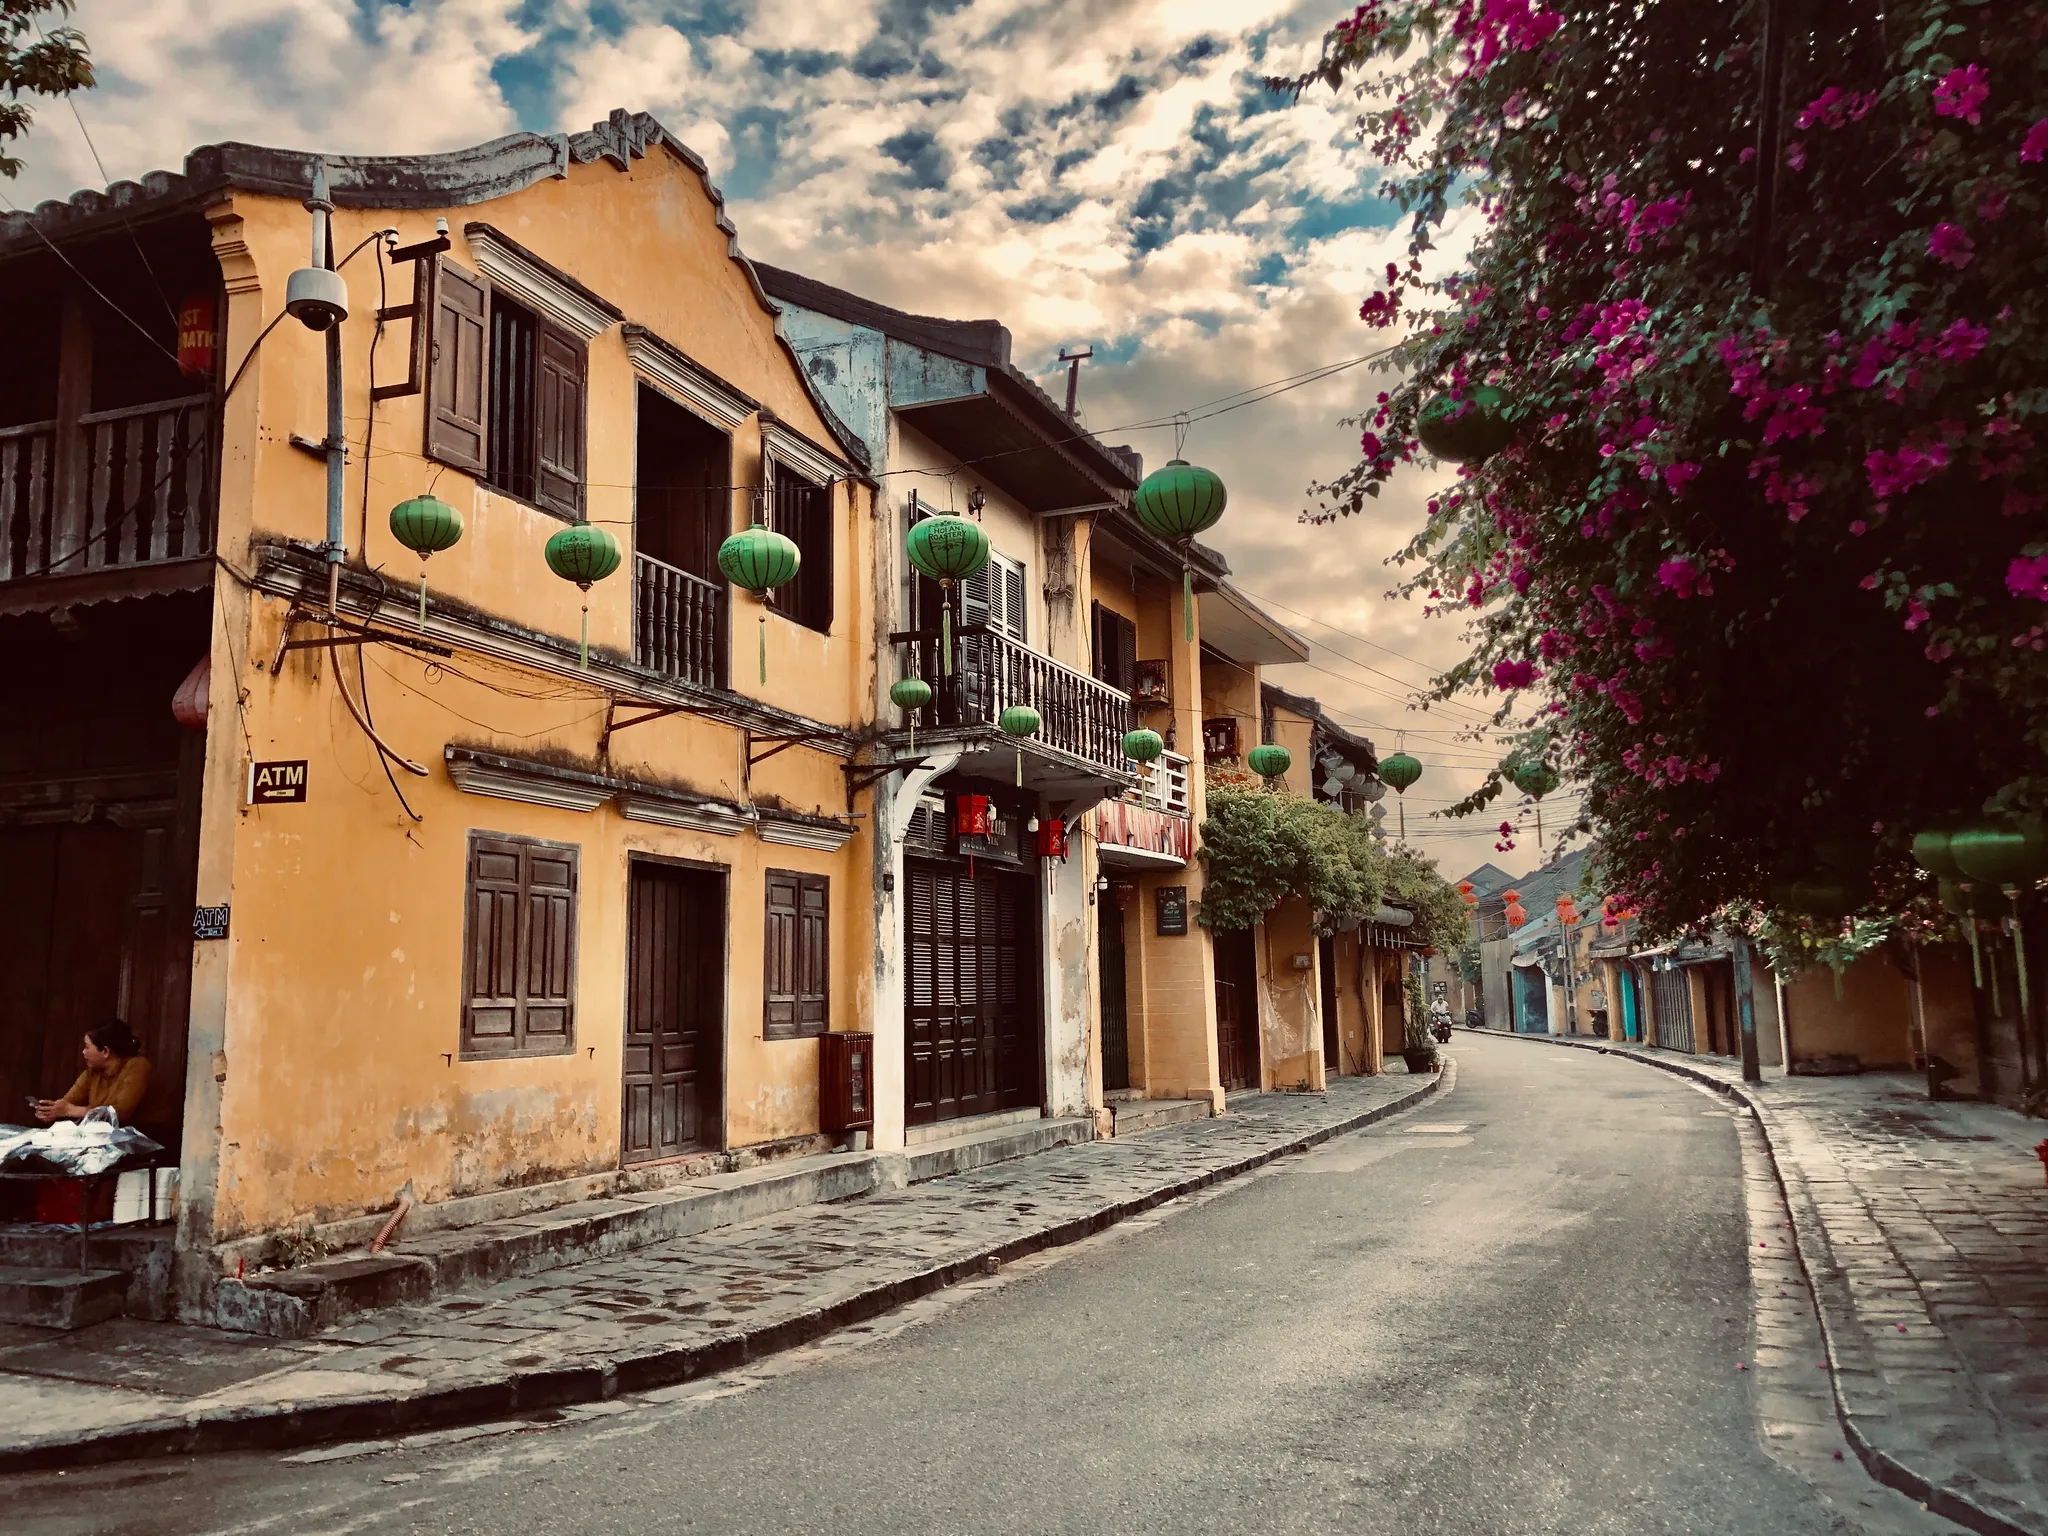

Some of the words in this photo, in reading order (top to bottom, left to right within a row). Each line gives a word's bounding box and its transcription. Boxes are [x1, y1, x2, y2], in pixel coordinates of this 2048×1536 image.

[928, 530, 967, 542] ROASTERY
[256, 765, 304, 787] ATM
[193, 908, 229, 927] ATM
